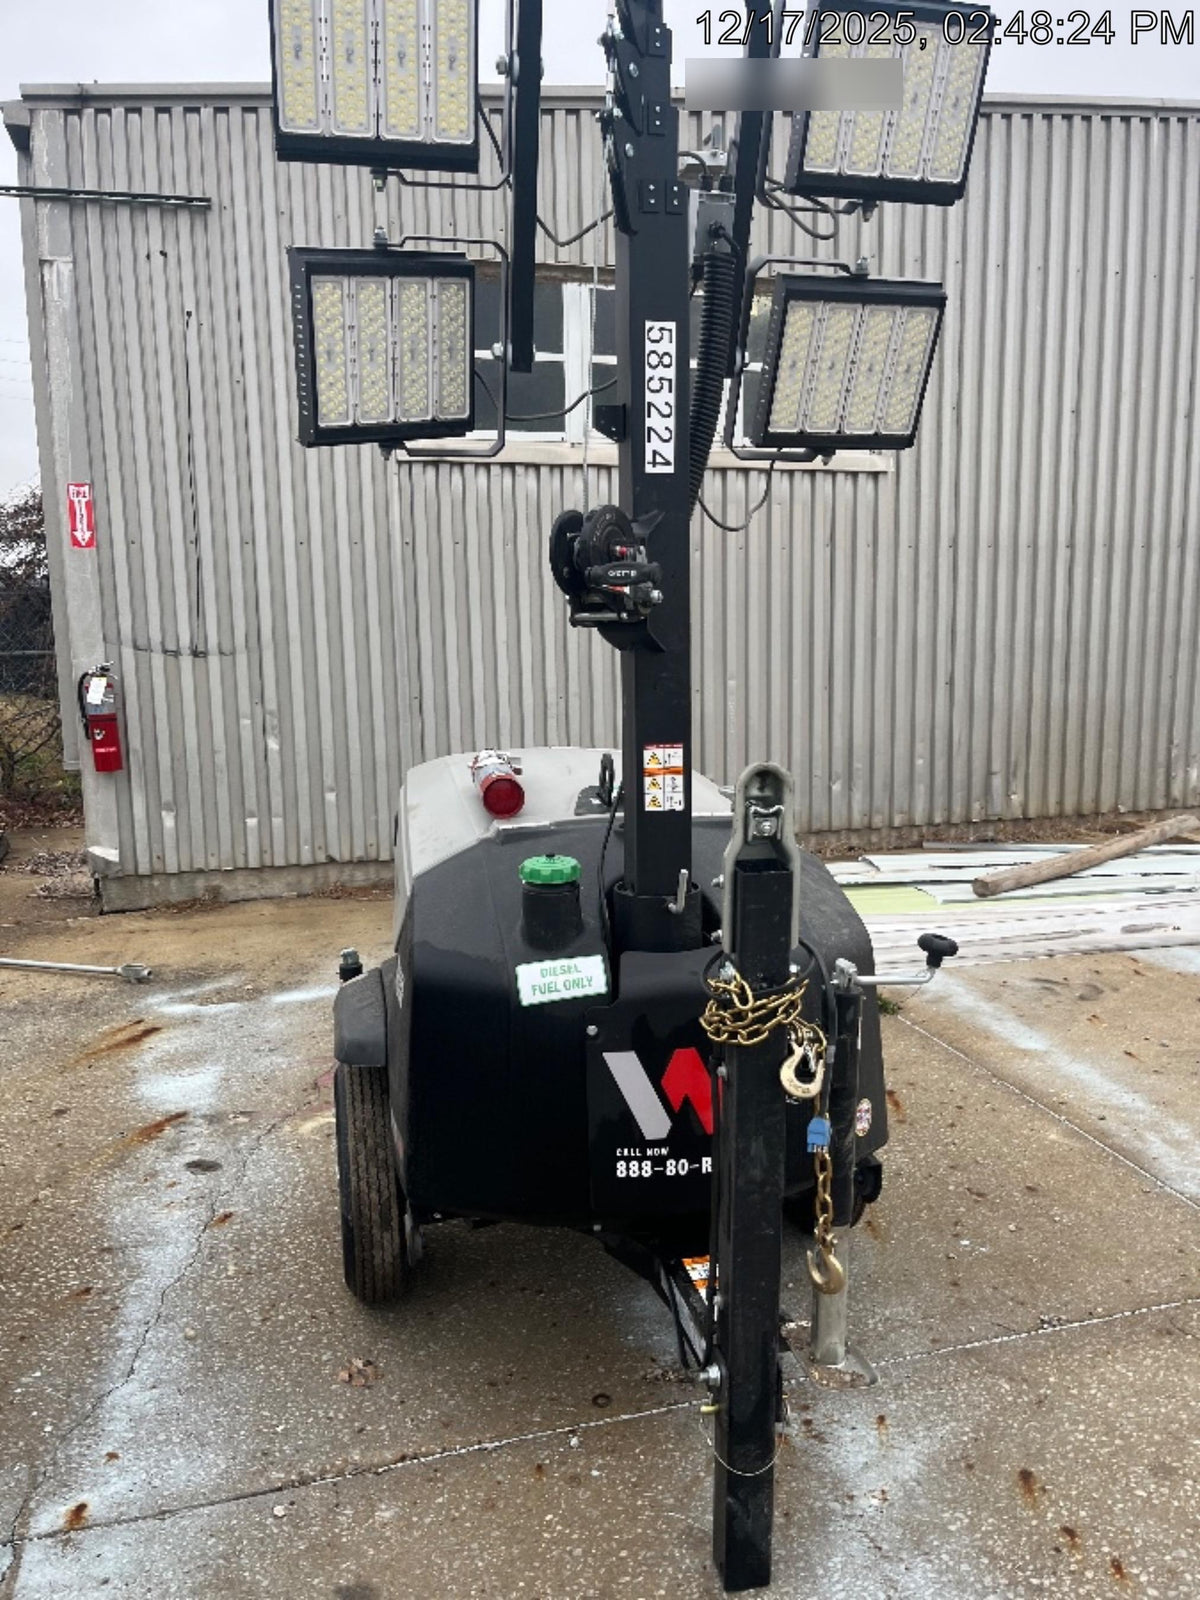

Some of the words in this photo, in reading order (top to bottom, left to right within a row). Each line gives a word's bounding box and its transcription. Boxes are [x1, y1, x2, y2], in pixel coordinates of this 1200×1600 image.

[646, 326, 673, 468] 585224
[540, 963, 582, 979] DIESEL
[531, 980, 561, 996] FUEL
[562, 975, 593, 991] ONLY
[616, 1147, 642, 1157] CALL
[646, 1146, 670, 1157] NOW
